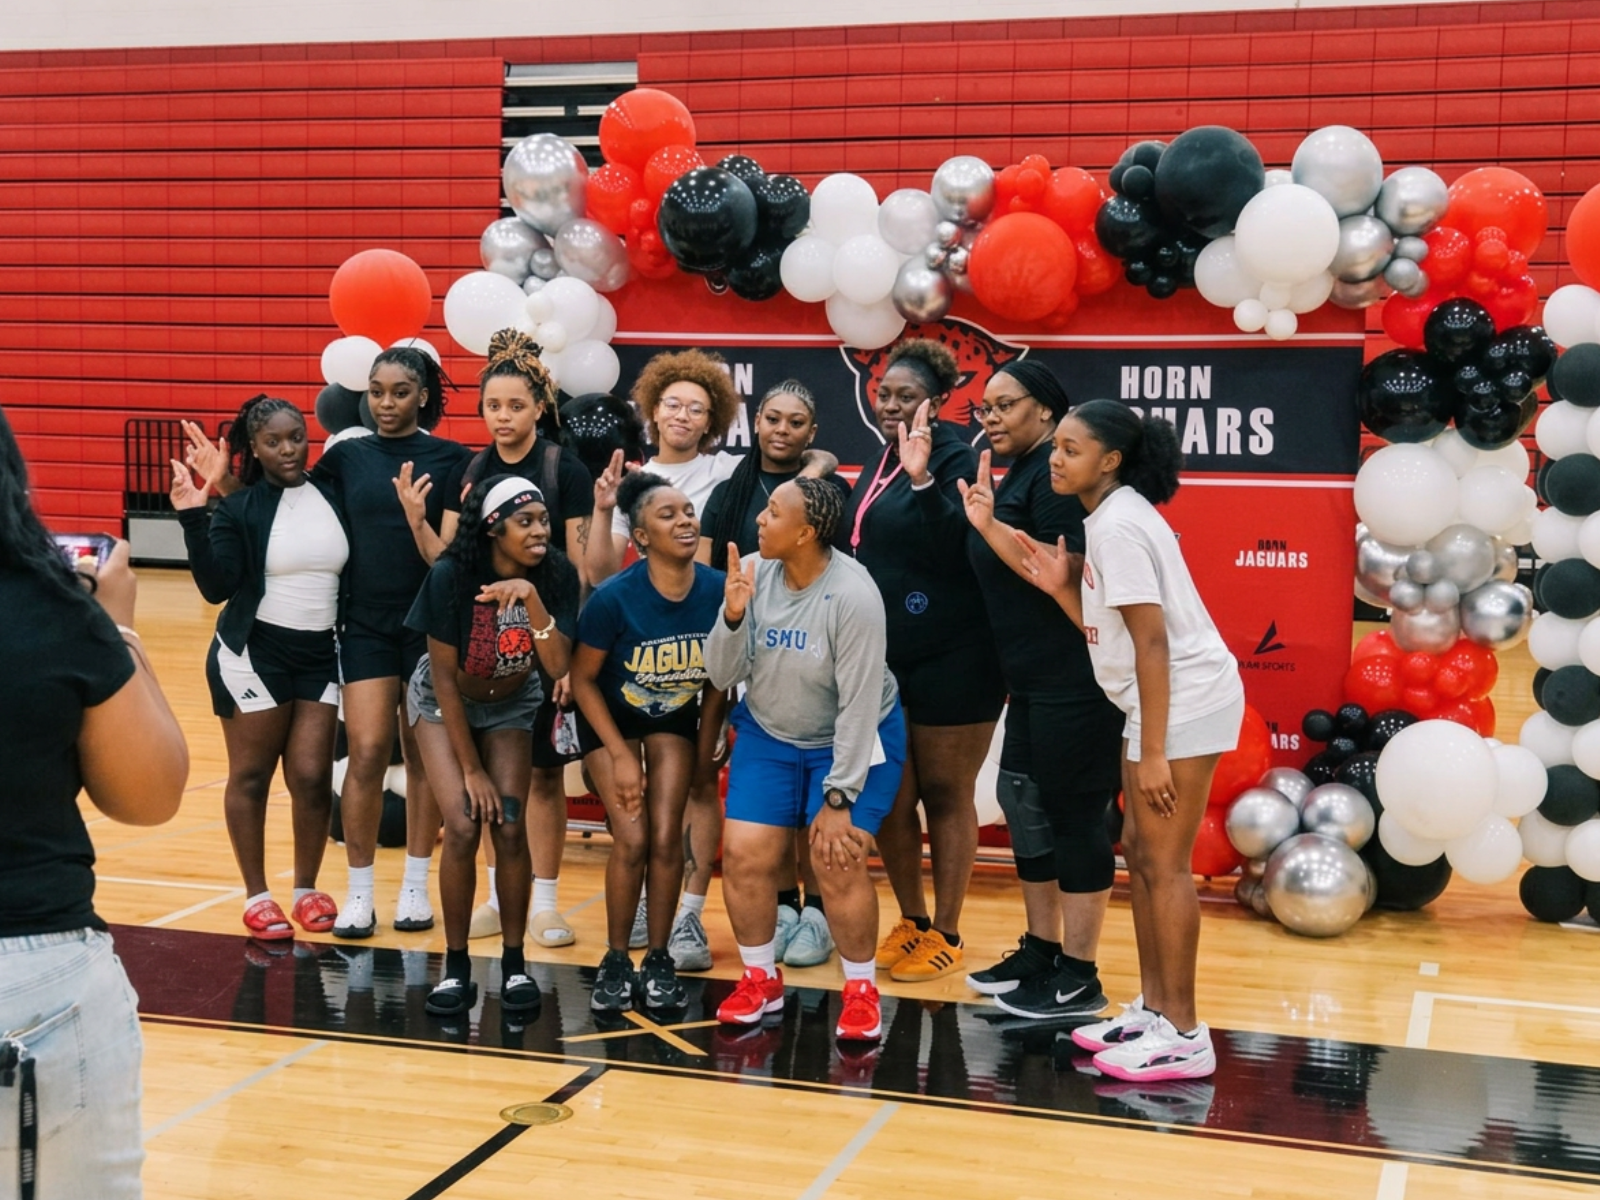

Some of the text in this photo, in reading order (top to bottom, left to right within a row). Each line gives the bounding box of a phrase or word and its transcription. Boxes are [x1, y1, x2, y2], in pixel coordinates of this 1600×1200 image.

[1120, 365, 1212, 399] HORN
[1235, 550, 1308, 568] JAGUARS
[765, 628, 808, 650] SMU
[624, 638, 706, 674] JAGUA
